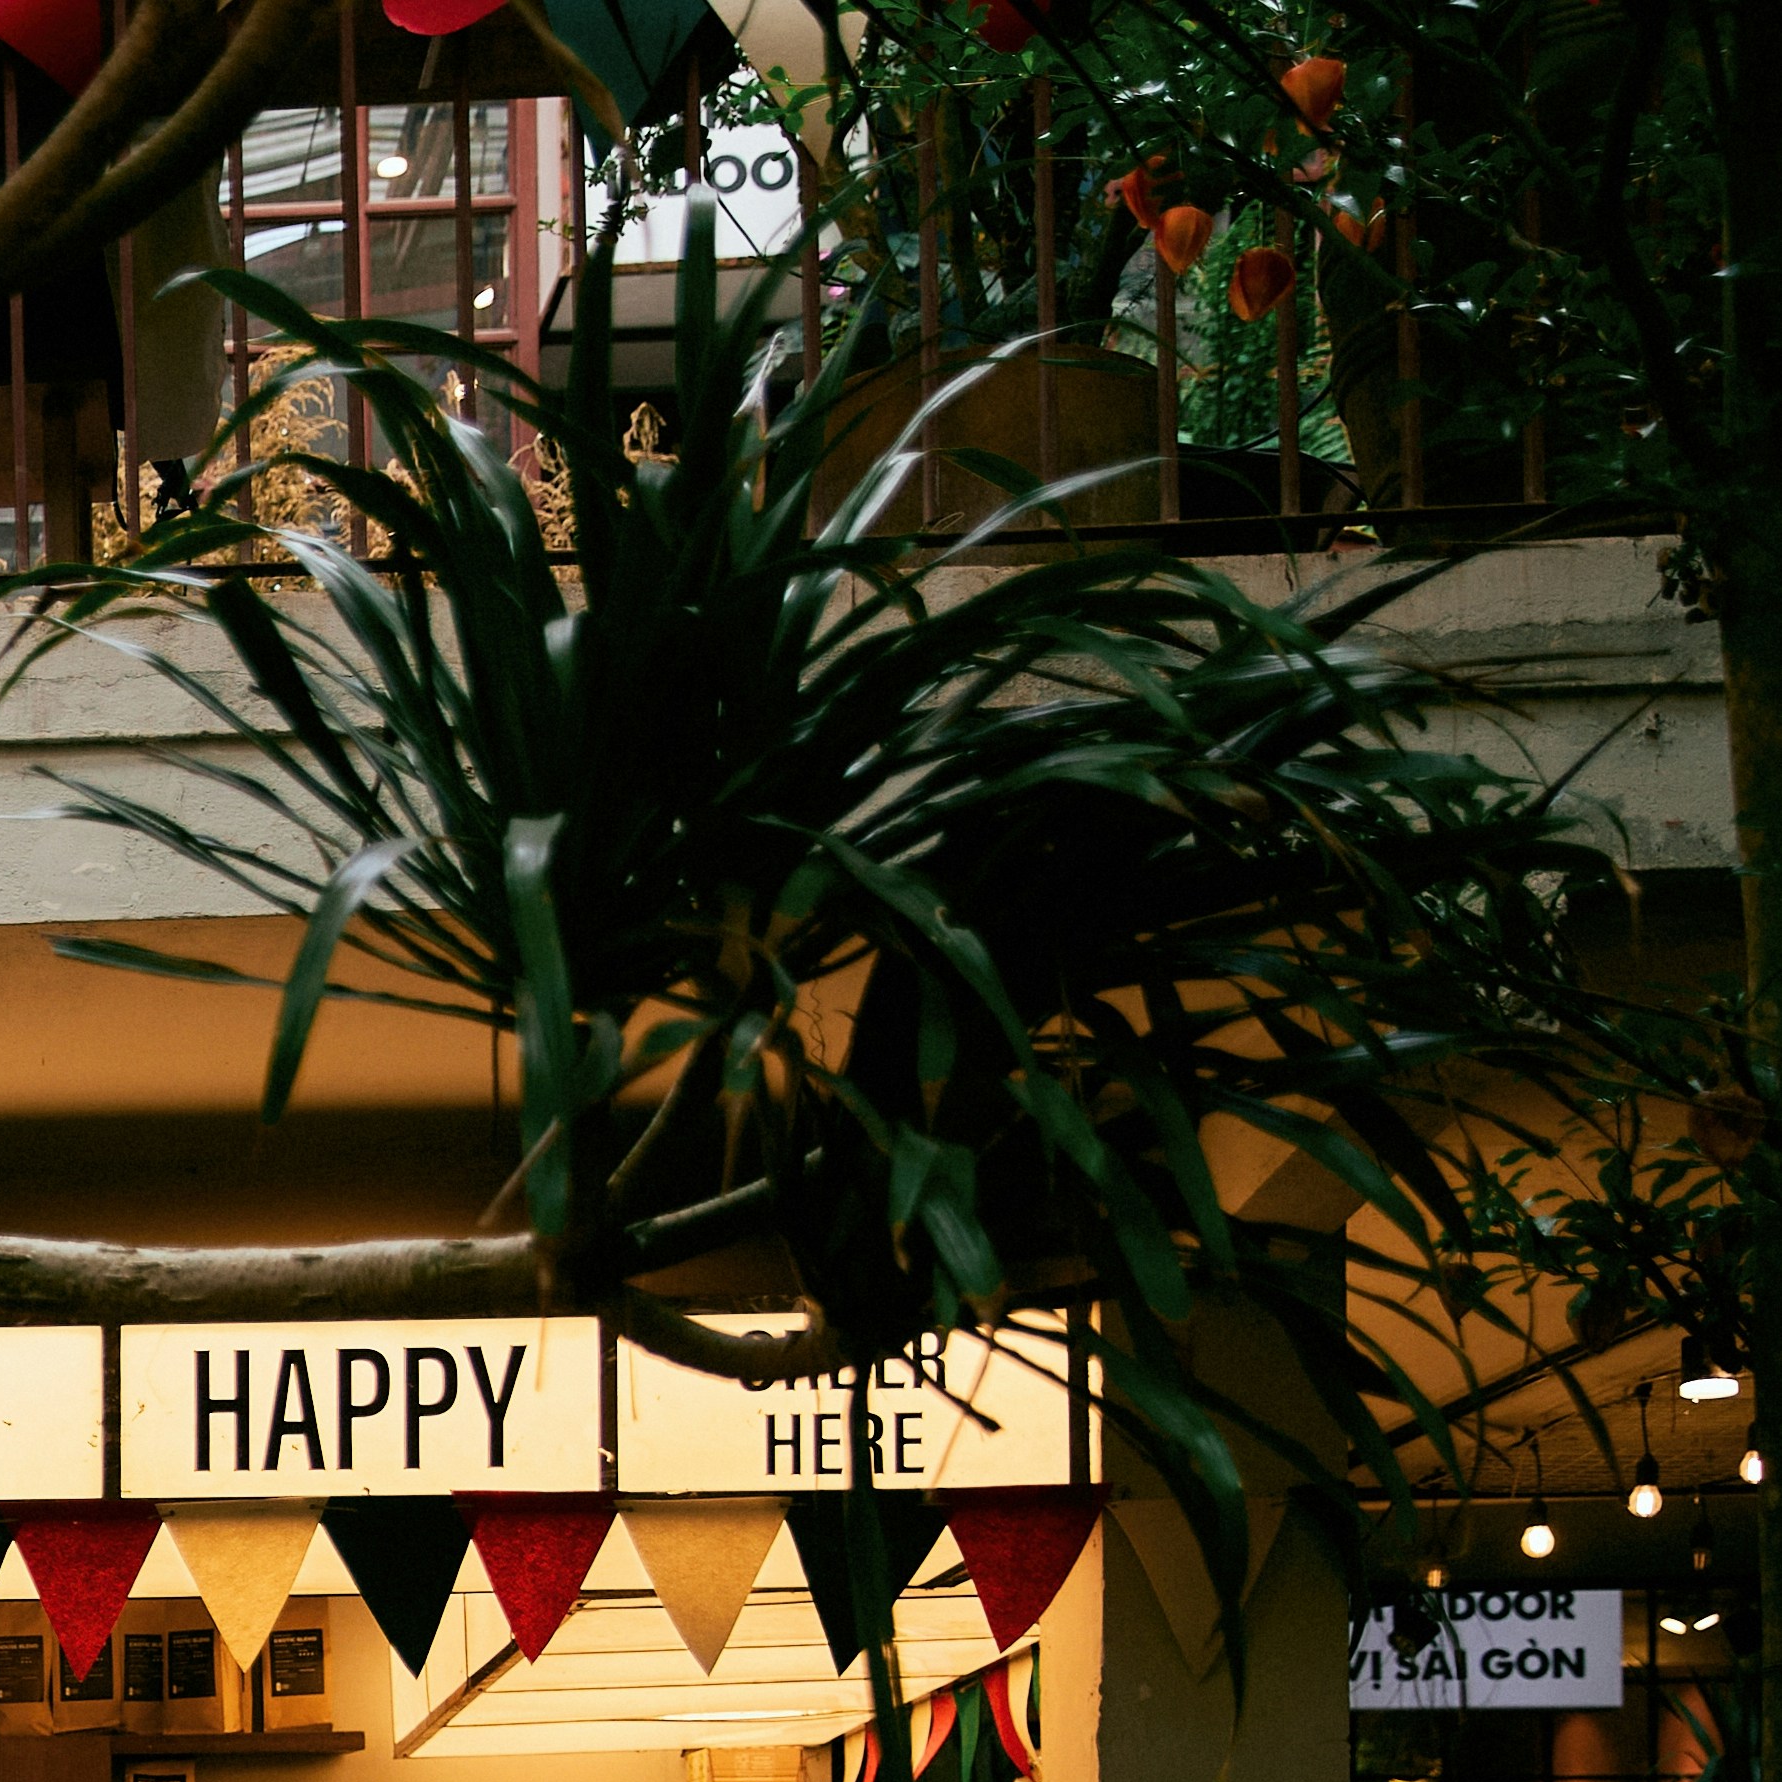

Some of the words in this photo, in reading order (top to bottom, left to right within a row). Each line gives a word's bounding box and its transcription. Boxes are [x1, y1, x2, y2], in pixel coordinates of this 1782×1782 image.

[194, 1345, 527, 1472] HAPPY
[765, 1412, 925, 1476] HERE
[1481, 1637, 1586, 1681] GÒN
